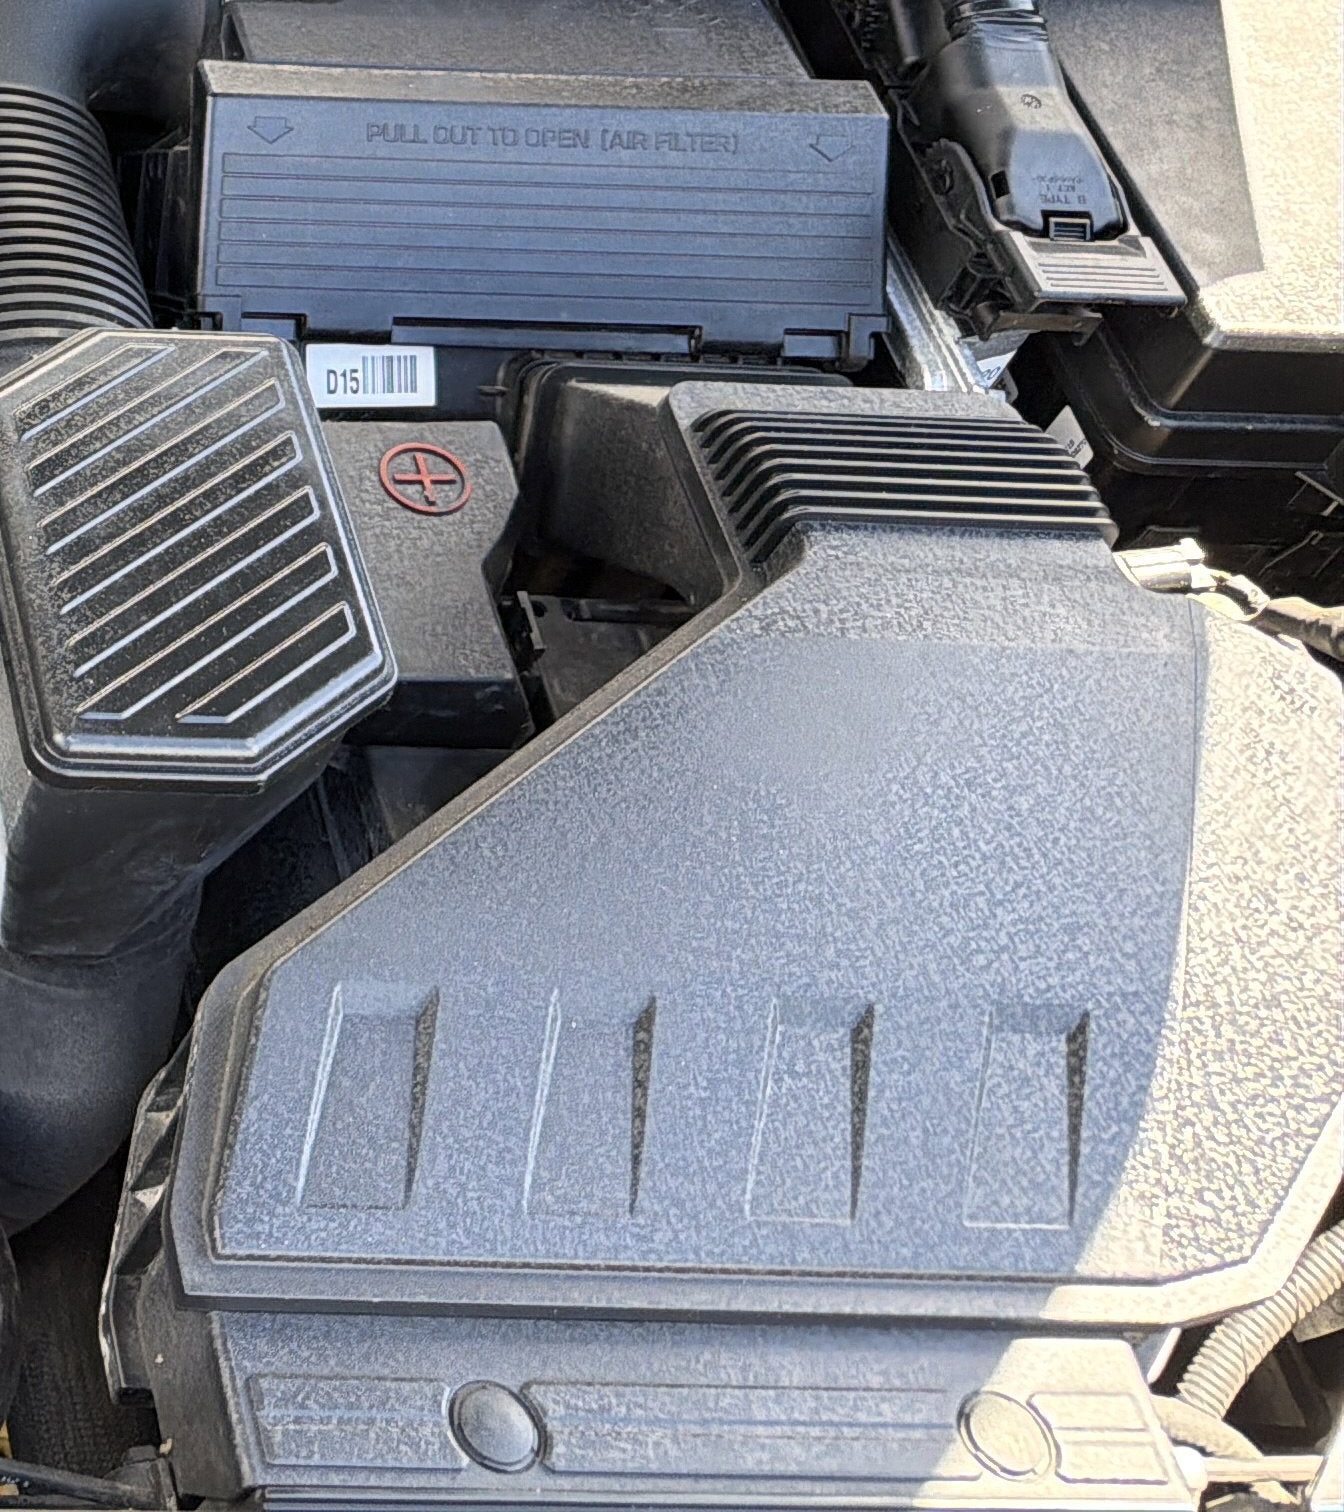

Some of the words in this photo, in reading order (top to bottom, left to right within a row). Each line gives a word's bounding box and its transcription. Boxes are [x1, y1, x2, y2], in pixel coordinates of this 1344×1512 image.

[365, 121, 428, 145] PULL
[433, 124, 482, 146] OUT
[490, 127, 517, 148] TO
[524, 127, 590, 150] OPEN
[326, 368, 360, 395] D15
